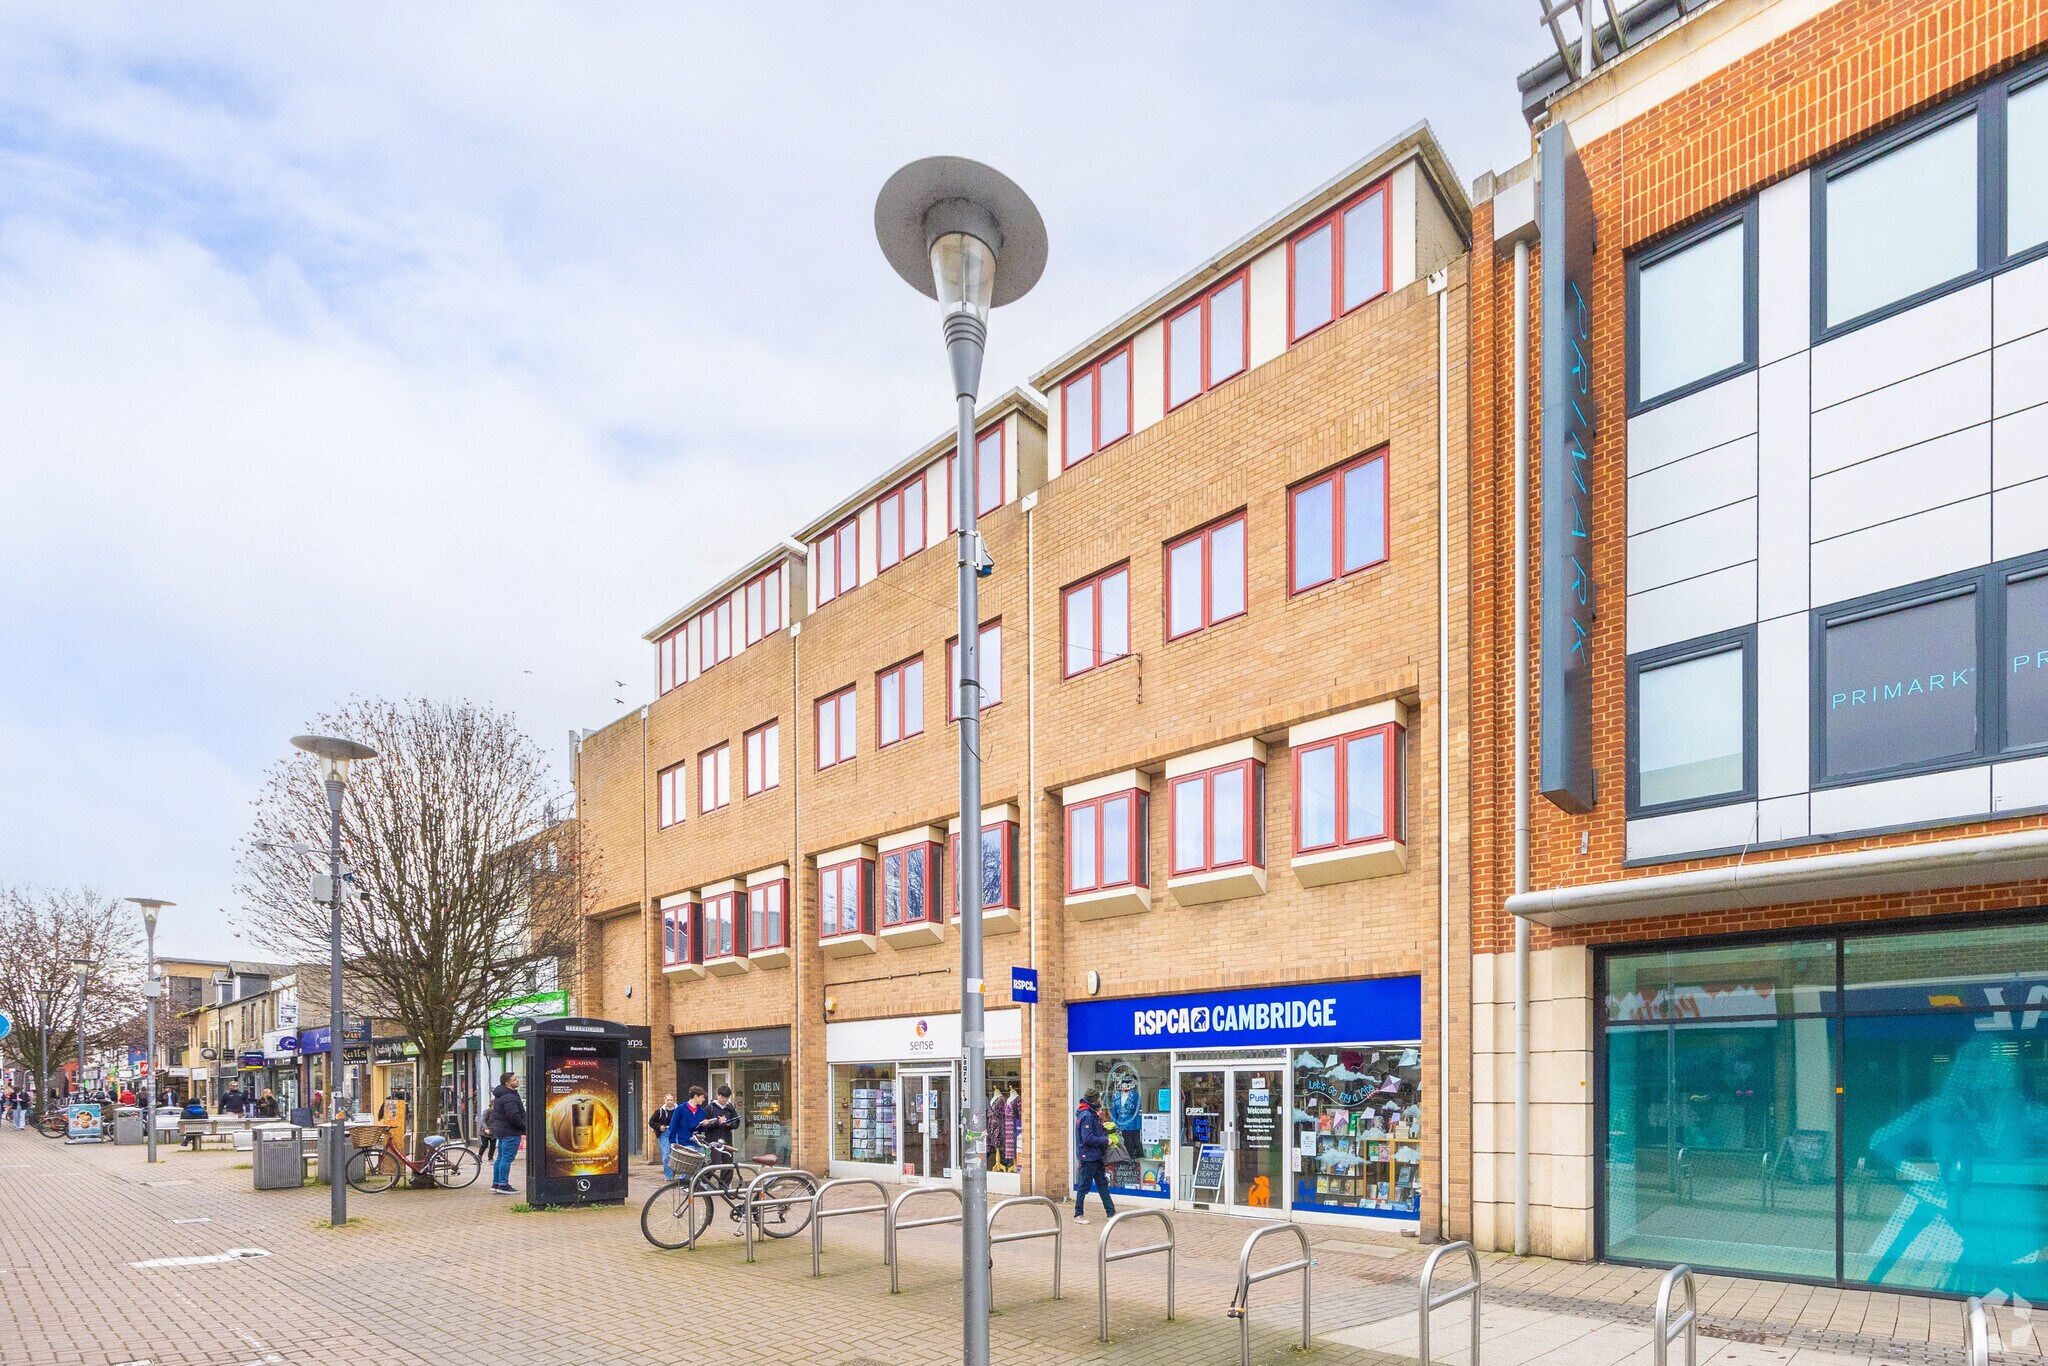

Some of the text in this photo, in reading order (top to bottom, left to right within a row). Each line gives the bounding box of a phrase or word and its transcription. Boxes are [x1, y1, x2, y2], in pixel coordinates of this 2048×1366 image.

[1571, 281, 1588, 667] PRIMARK
[1831, 666, 1971, 710] PRIMARK
[1013, 978, 1034, 991] RSPCA
[1134, 998, 1337, 1036] RSPCA CAMBRIDGE
[722, 1034, 748, 1052] sharps
[909, 1039, 935, 1051] sense
[753, 1082, 780, 1092] COME IN
[1249, 1092, 1269, 1103] Push
[1247, 1106, 1272, 1115] Welcome
[1210, 1156, 1225, 1164] BOOKS
[1197, 1170, 1220, 1178] CHEAPEST
